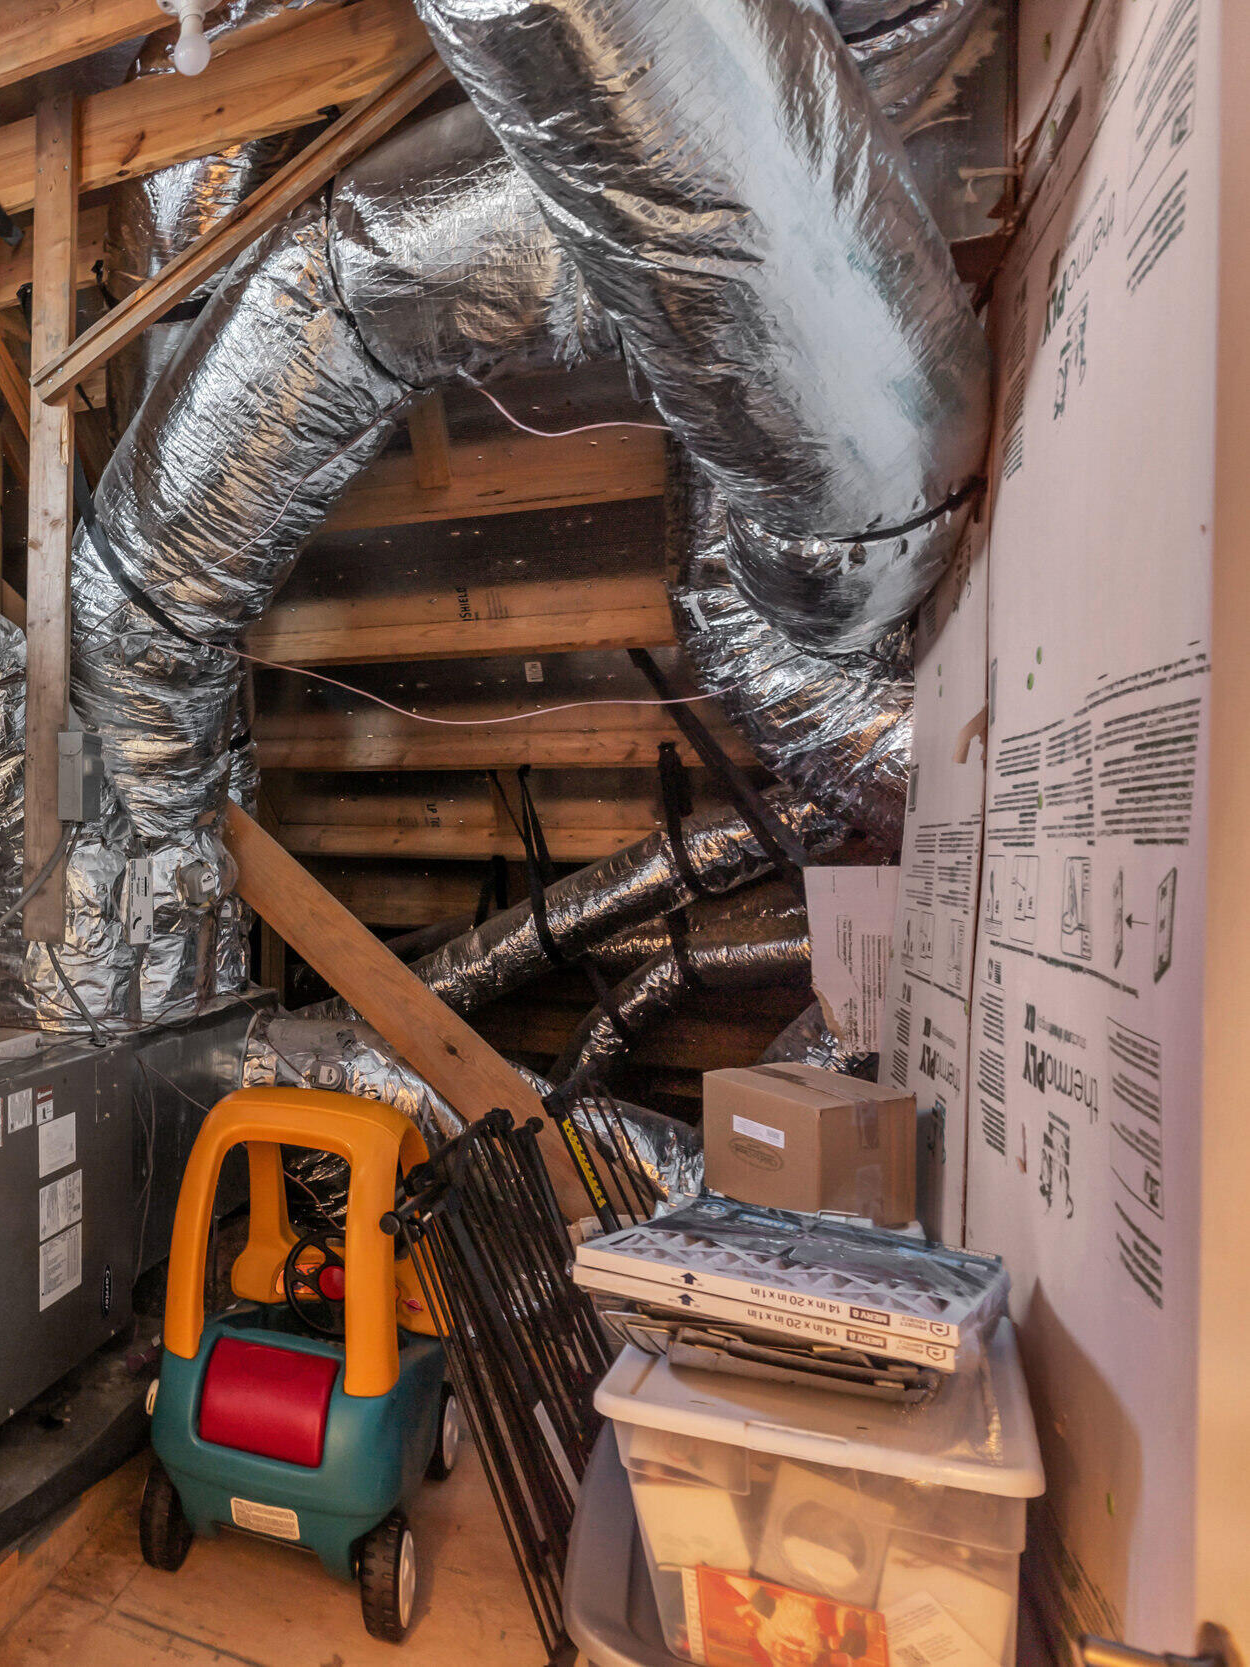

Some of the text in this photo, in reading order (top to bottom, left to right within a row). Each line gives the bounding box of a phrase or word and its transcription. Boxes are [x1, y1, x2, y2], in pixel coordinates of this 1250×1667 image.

[1022, 1040, 1099, 1125] thermoPLY
[750, 1287, 760, 1298] in
[778, 1292, 787, 1302] in
[790, 1295, 805, 1307] 20
[816, 1300, 826, 1311] in
[747, 1308, 757, 1318] in
[829, 1304, 840, 1314] 14
[774, 1314, 784, 1324] in
[786, 1317, 801, 1329] 20
[813, 1323, 823, 1333] in
[825, 1326, 837, 1336] 14
